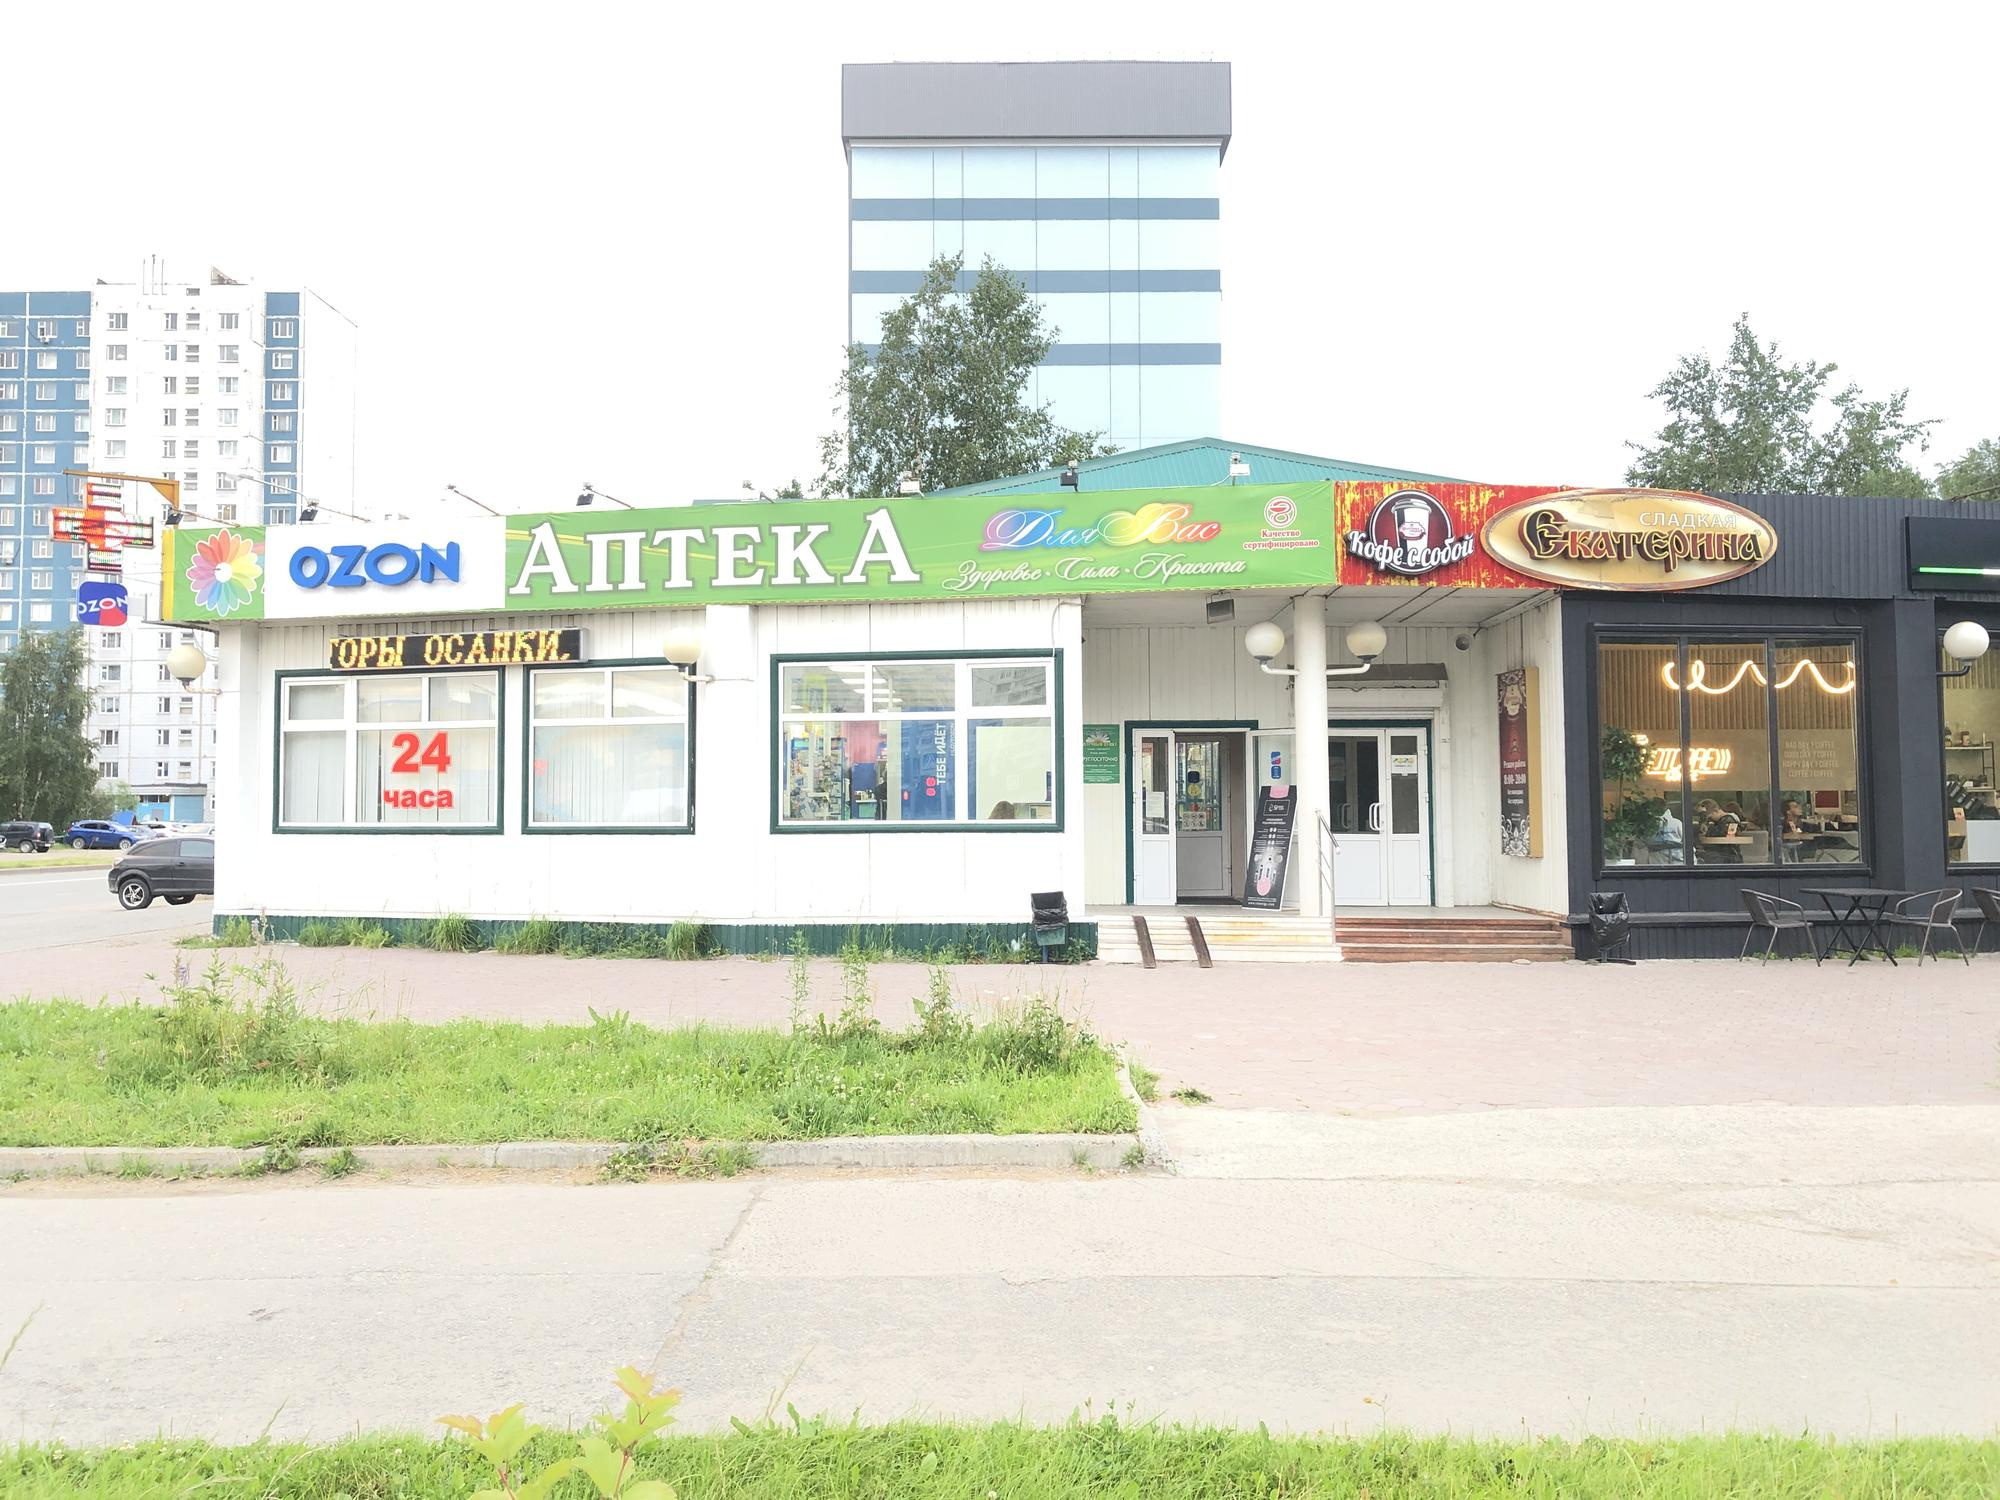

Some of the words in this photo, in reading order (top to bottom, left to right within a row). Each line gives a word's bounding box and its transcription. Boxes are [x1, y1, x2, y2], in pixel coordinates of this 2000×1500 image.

[980, 509, 1100, 551] Для
[1097, 503, 1221, 547] Вас
[1260, 529, 1301, 538] Качество
[1639, 511, 1737, 529] СЛАДКАЯ
[507, 507, 922, 596] АПТЕКА
[1243, 540, 1320, 552] сертифицировано
[1349, 530, 1407, 570] Кофе
[1420, 535, 1475, 567] собой
[288, 541, 461, 589] OZON
[941, 559, 1042, 592] Здоровье
[1054, 556, 1119, 582] Сила
[1133, 552, 1247, 585] Красота
[78, 594, 128, 615] OZON
[391, 731, 452, 774] 24
[934, 722, 946, 754] ИДЁТ
[936, 757, 946, 786] ТЕБЕ
[383, 788, 454, 810] часа
